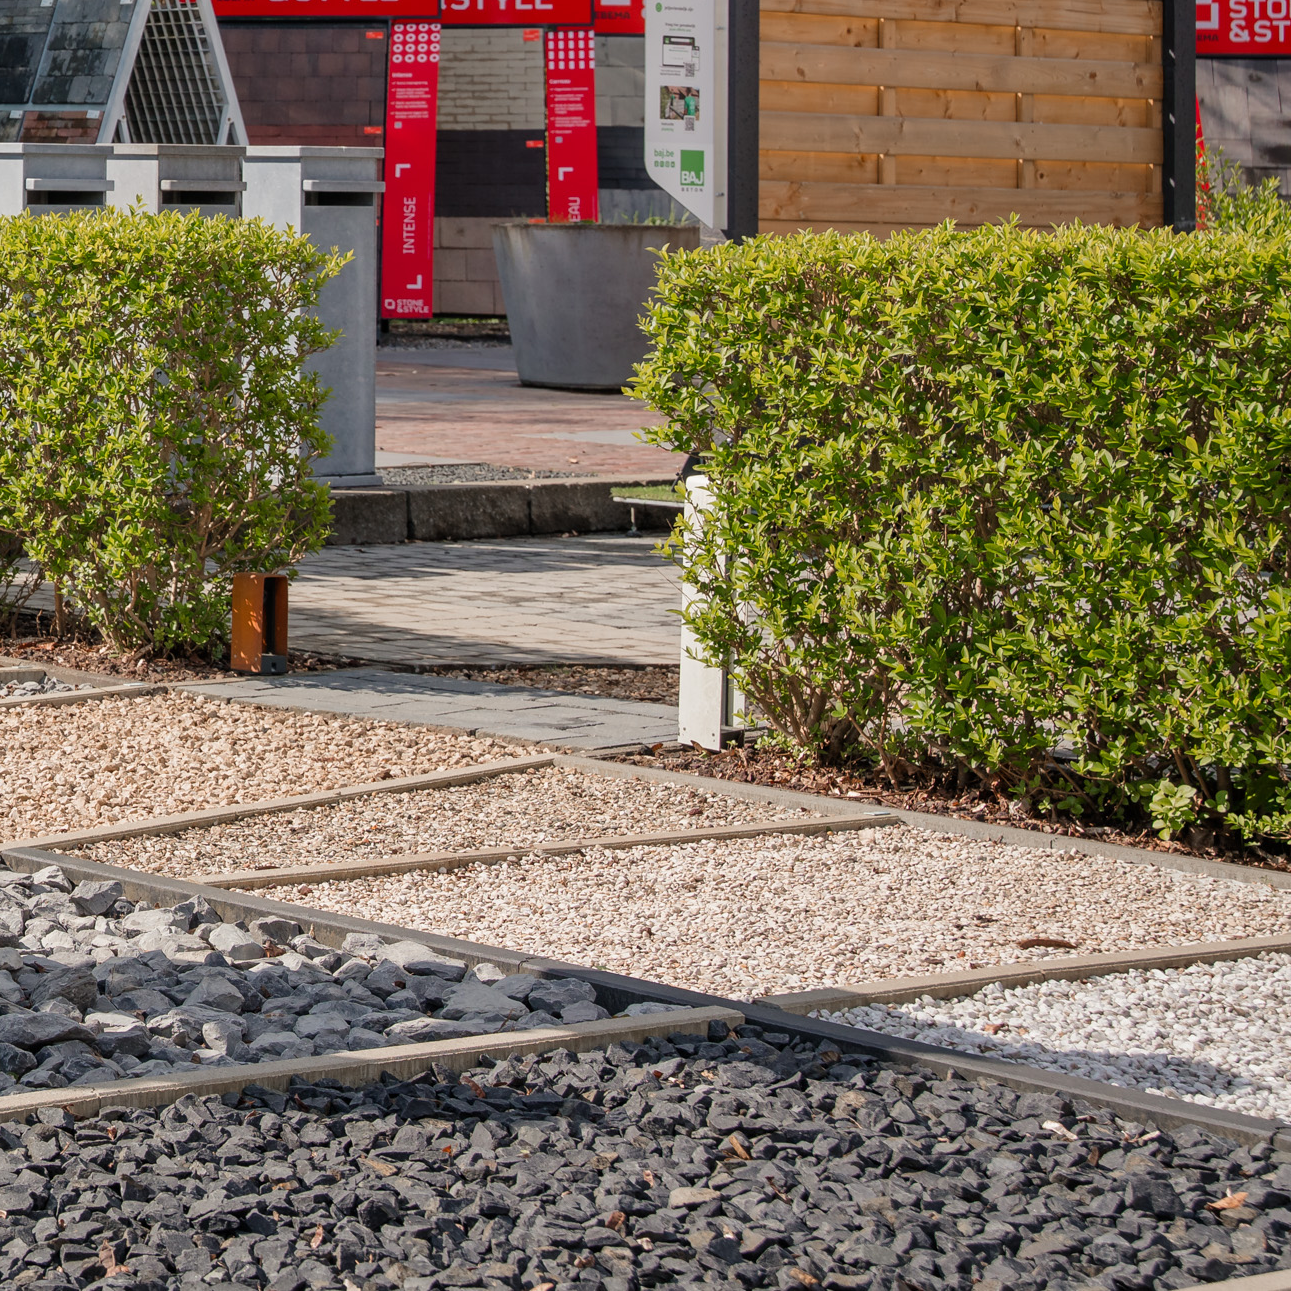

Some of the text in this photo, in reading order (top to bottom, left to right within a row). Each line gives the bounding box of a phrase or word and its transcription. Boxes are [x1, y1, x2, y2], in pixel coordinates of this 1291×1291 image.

[653, 148, 675, 159] baj.be
[681, 171, 704, 184] BAJ
[402, 196, 417, 255] INTENSE
[396, 298, 424, 307] STONE
